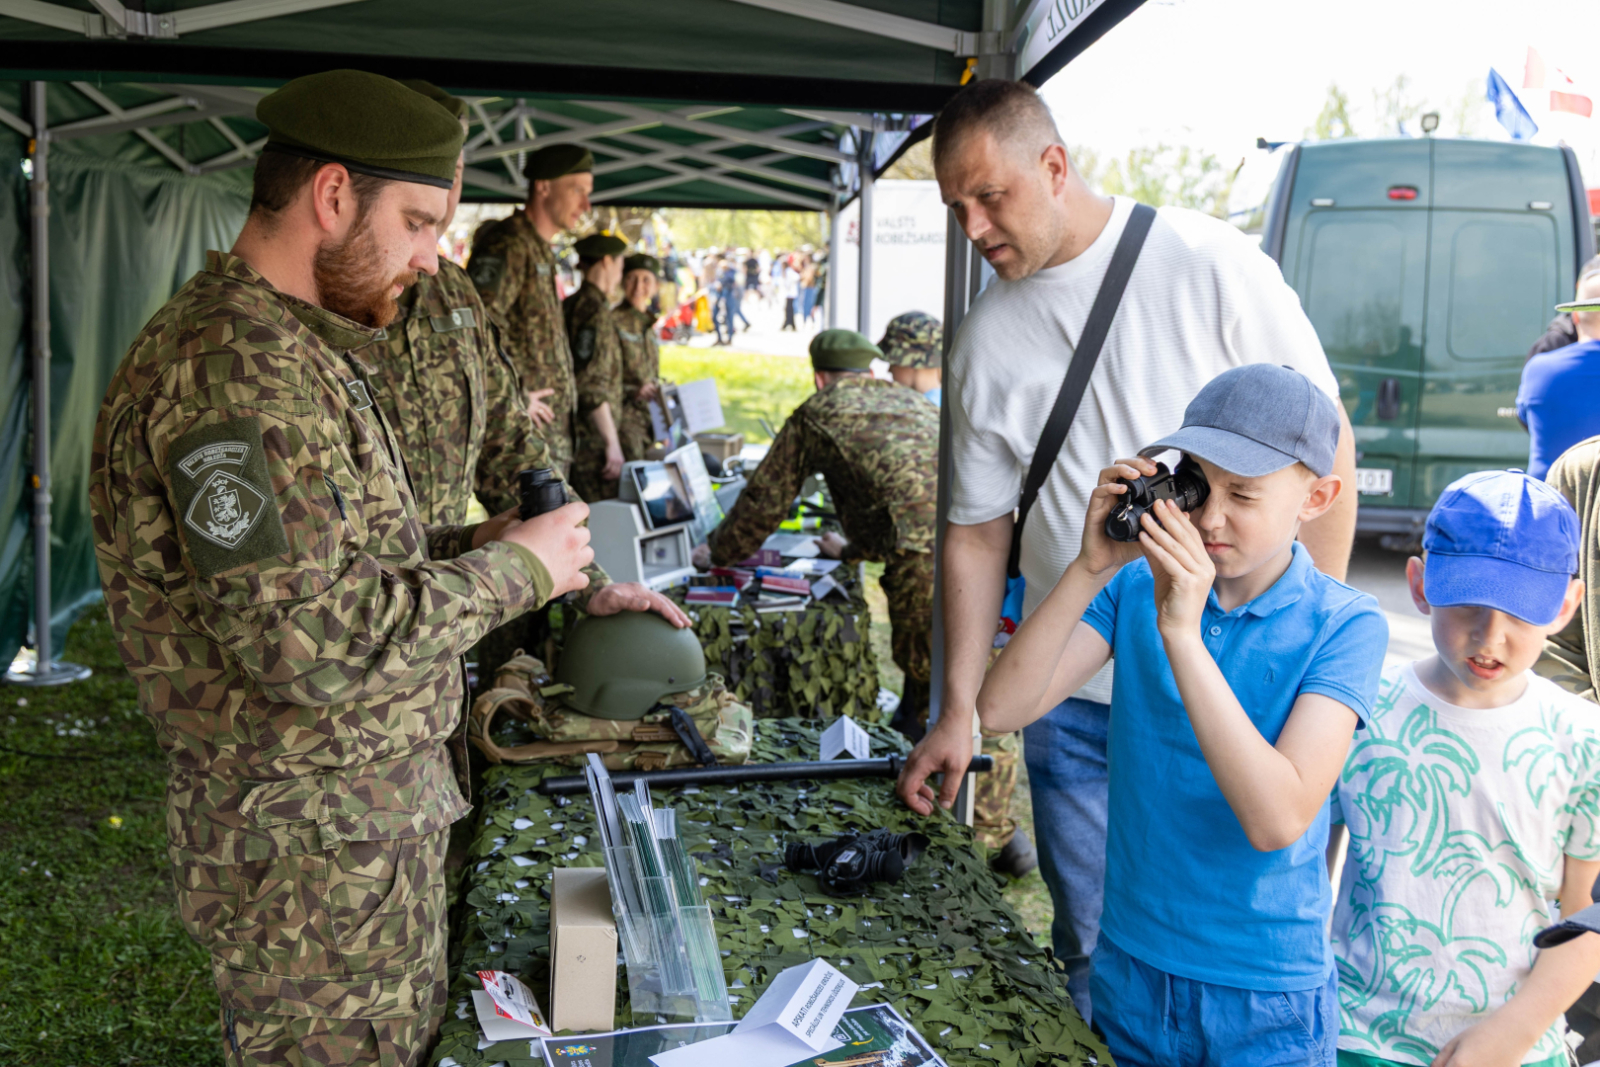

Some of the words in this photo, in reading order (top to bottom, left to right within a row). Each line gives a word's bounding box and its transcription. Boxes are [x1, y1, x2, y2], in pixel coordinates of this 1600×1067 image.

[877, 216, 915, 228] VALSTS
[792, 1007, 808, 1027] APSKATI
[805, 985, 824, 1010] ROBEŽSARDZES
[817, 1012, 825, 1020] UN
